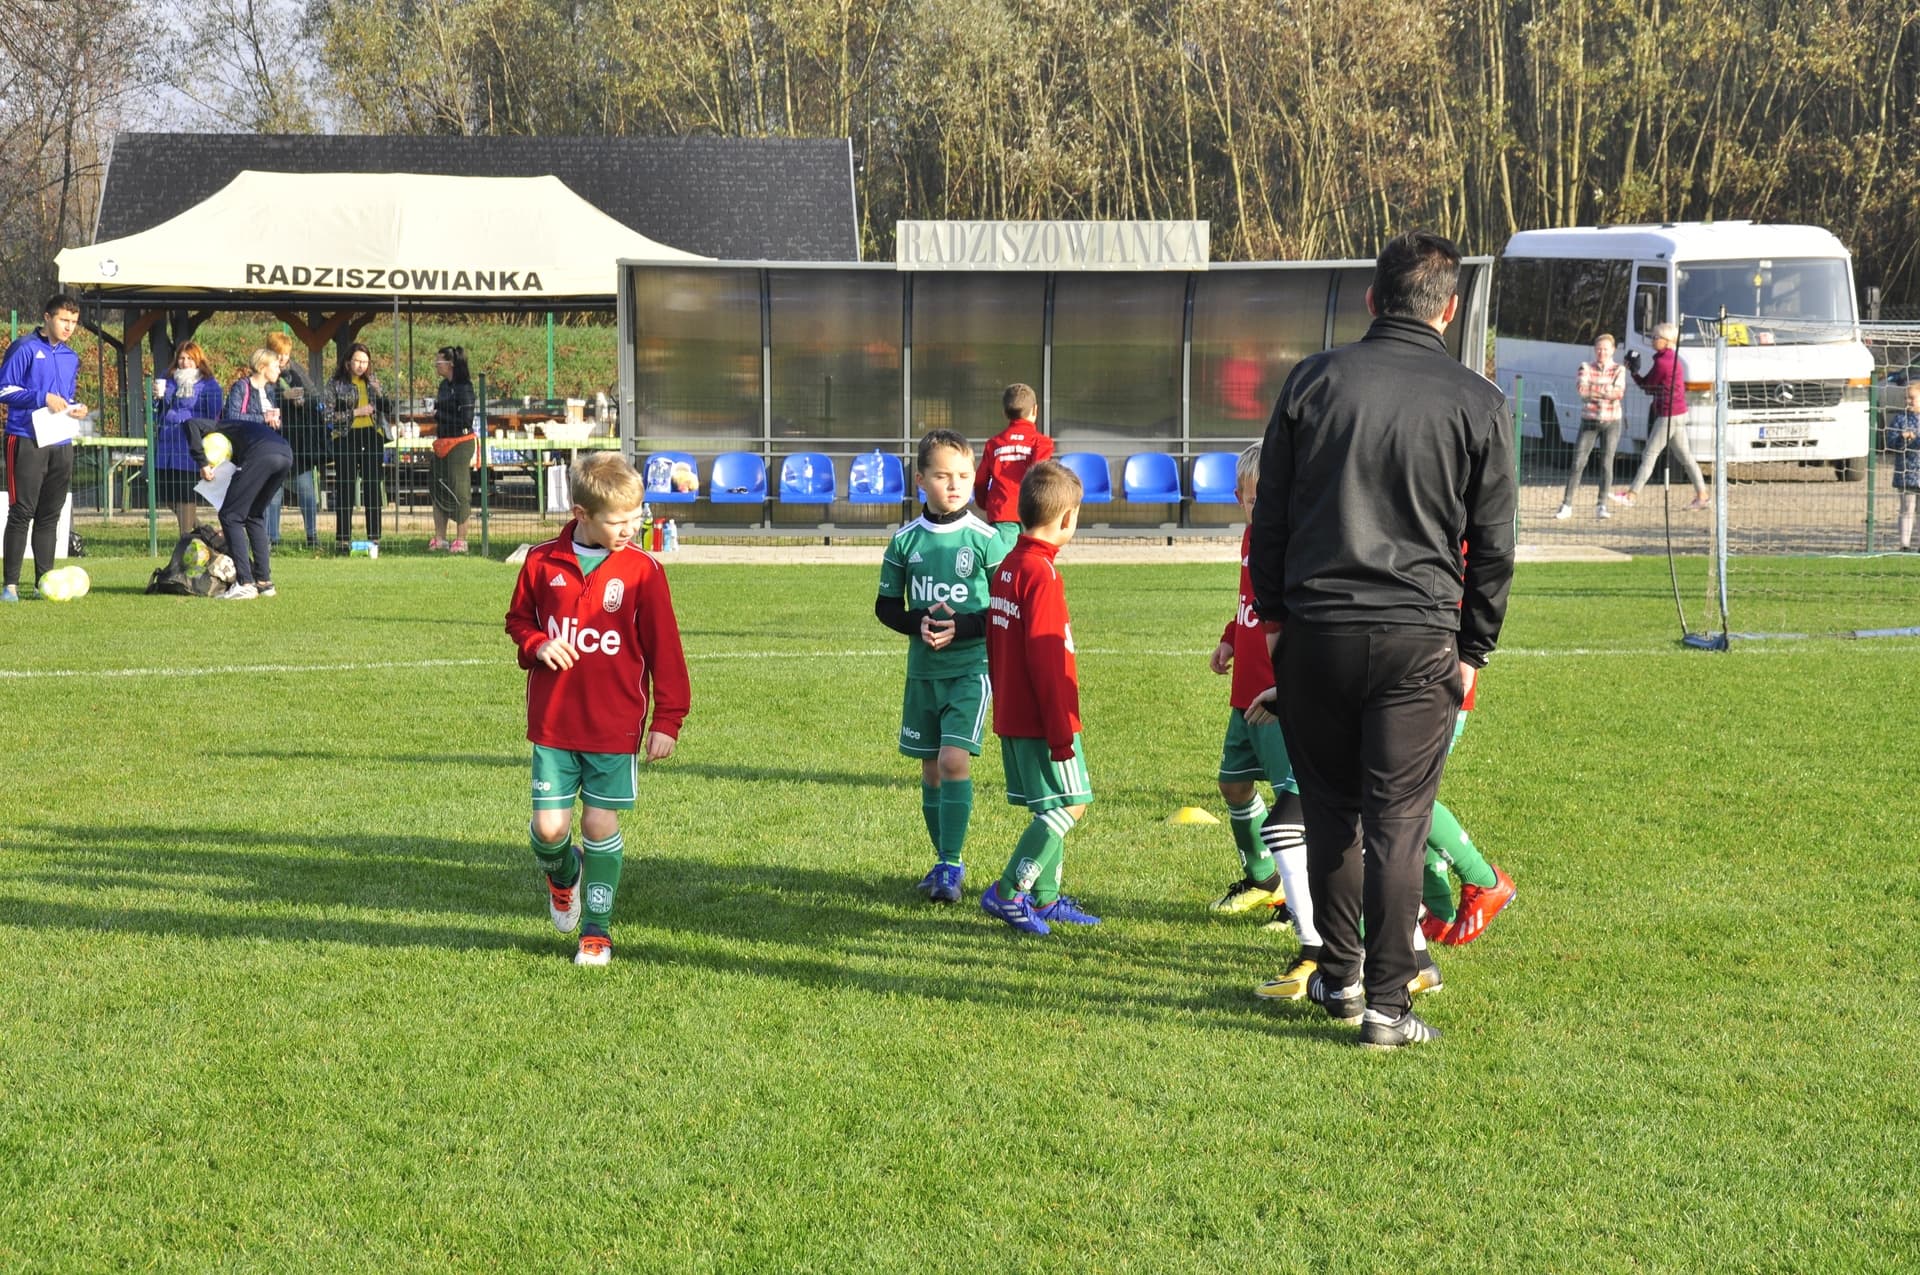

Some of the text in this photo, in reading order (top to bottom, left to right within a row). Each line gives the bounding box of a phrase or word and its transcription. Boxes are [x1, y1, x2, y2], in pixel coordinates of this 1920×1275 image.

[903, 222, 1203, 264] RADZISZOWIANKA
[245, 263, 544, 291] RADZISZOWIANKA
[911, 575, 969, 603] Nice
[1001, 570, 1012, 583] KS
[547, 615, 621, 656] Nice
[902, 726, 921, 740] Nice
